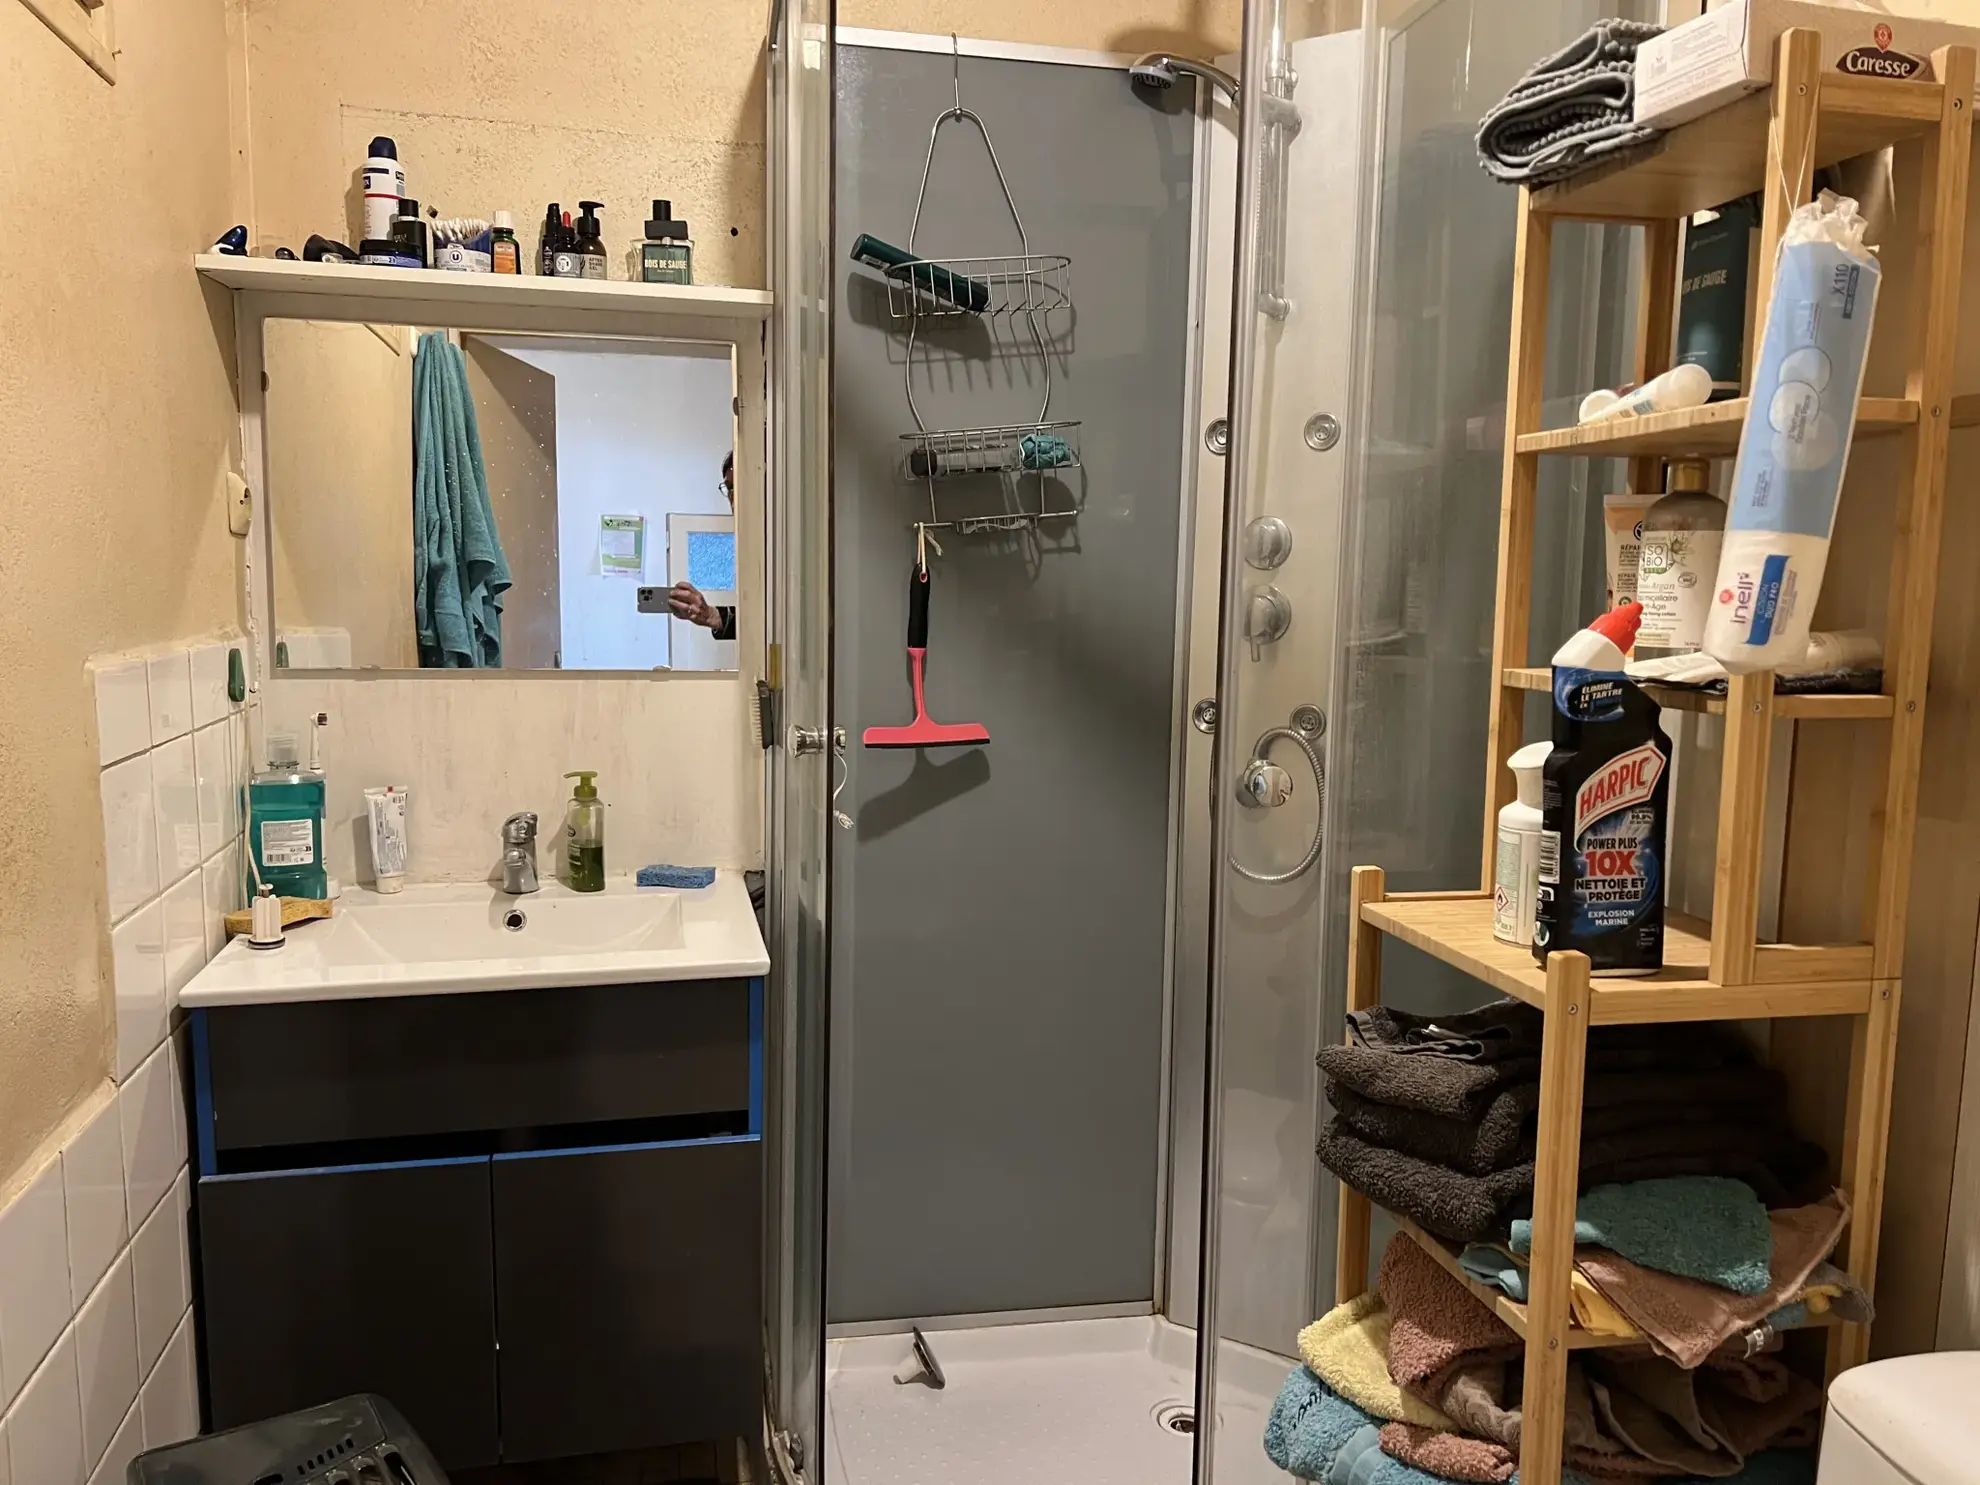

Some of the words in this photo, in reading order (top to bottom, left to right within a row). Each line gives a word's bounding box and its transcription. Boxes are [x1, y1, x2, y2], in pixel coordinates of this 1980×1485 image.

[1845, 51, 1911, 76] Caresse
[451, 253, 460, 261] U
[644, 259, 658, 269] BOIS
[659, 259, 667, 269] DE
[1832, 264, 1848, 296] X110
[1647, 545, 1663, 555] SO
[1581, 682, 1614, 694] ÉLIMINE
[1581, 694, 1590, 702] LE
[1592, 688, 1623, 700] TARTRE
[1579, 756, 1652, 820] HARPIC
[1587, 838, 1616, 849] POWER
[1618, 838, 1637, 848] PLUS
[1585, 851, 1636, 876] 10X
[1576, 879, 1628, 890] NETTOIE
[1631, 878, 1646, 888] ET
[1589, 889, 1640, 901] PROTÈGE
[1588, 910, 1635, 918] EXPLOSION
[1595, 918, 1629, 926] MARINE
